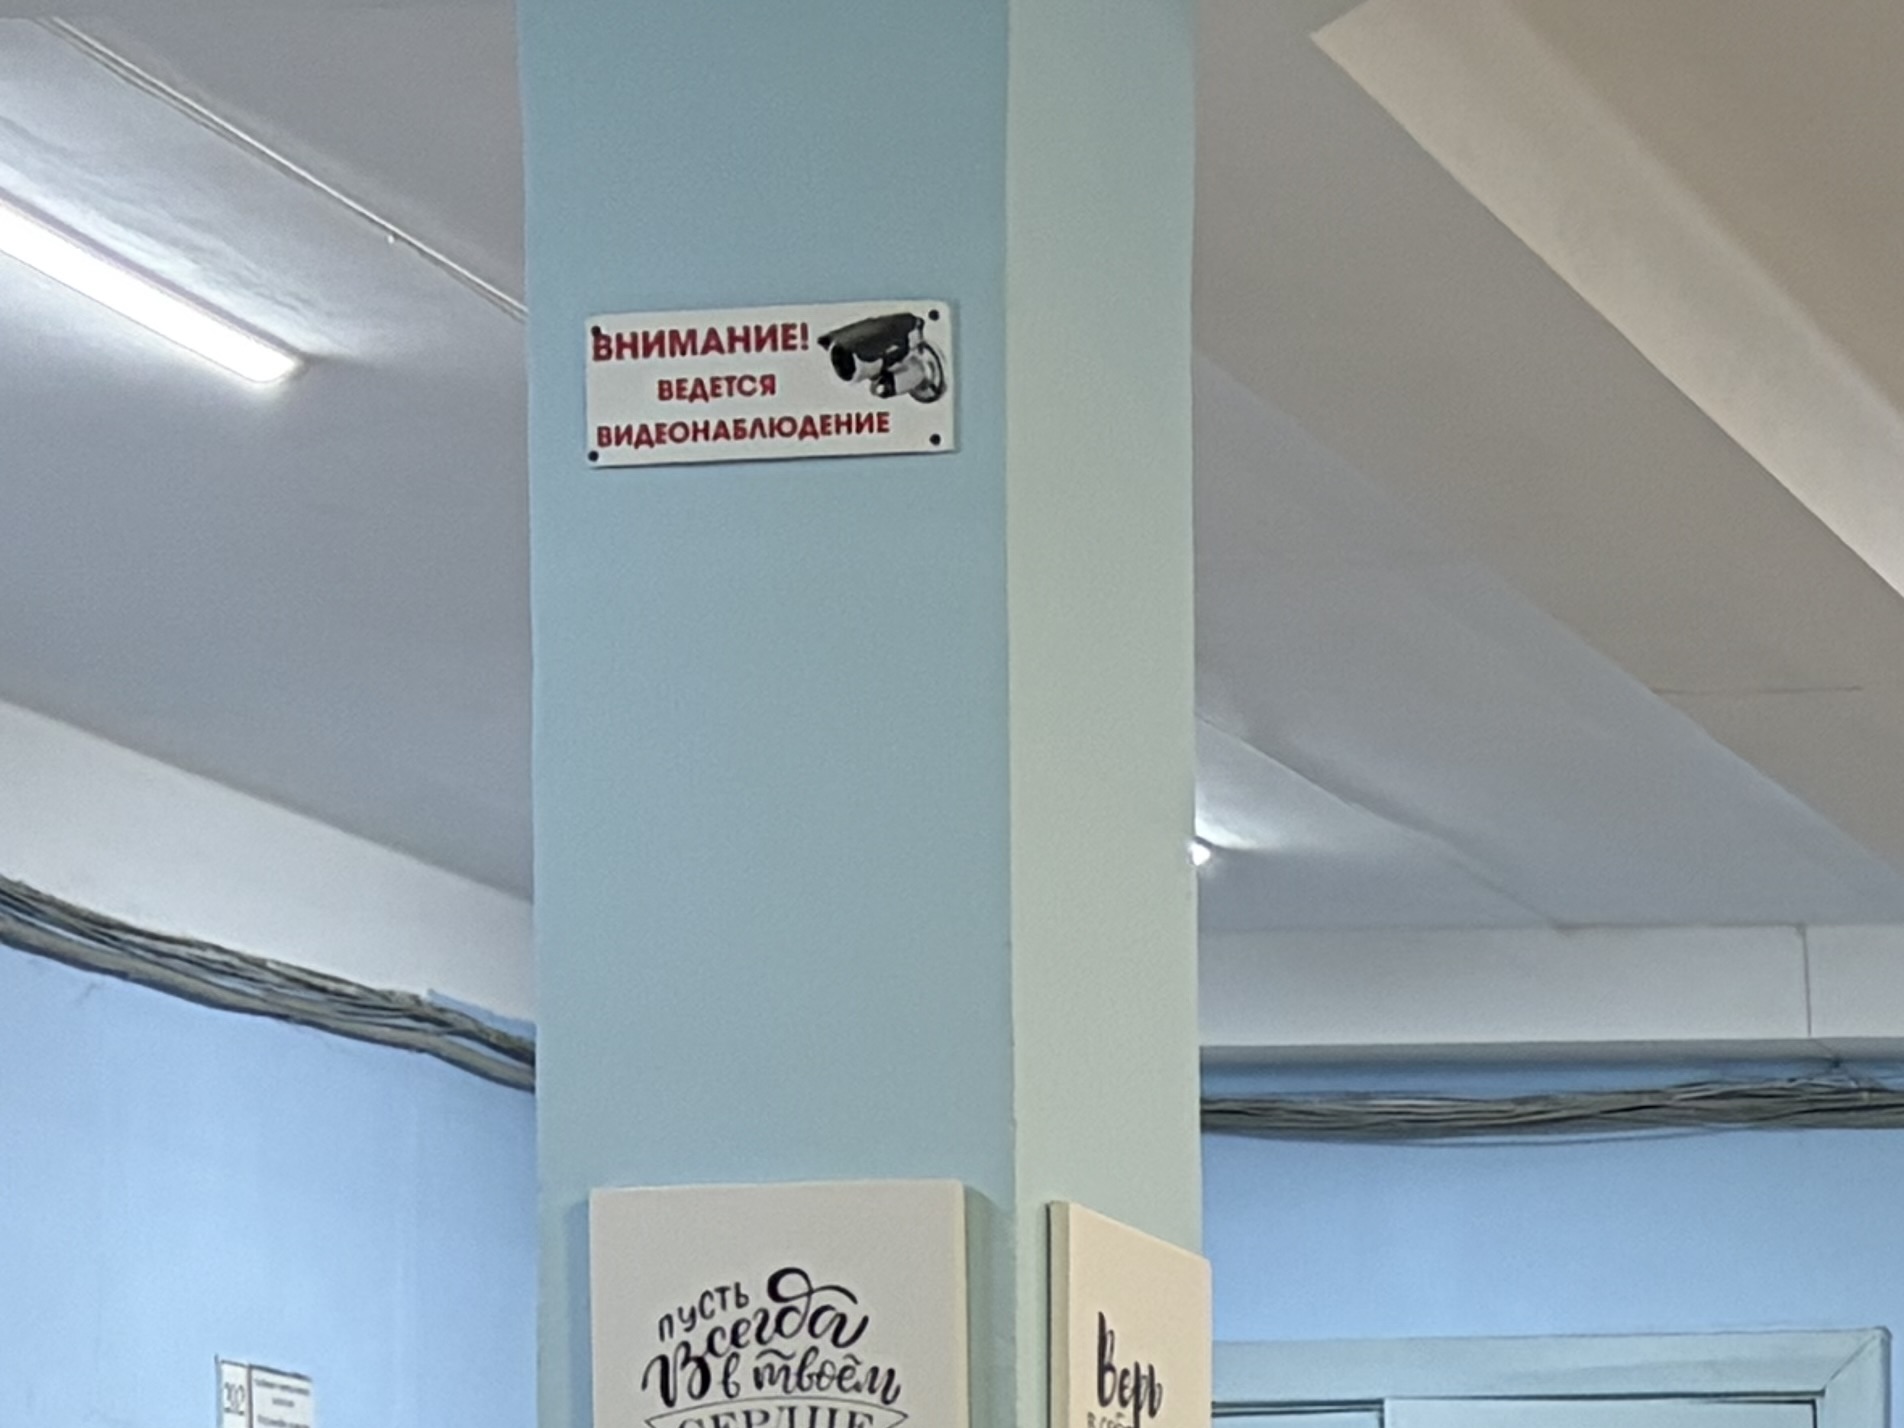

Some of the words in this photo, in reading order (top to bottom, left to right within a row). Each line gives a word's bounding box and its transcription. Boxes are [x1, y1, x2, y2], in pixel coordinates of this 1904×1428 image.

[592, 322, 809, 362] ВНИМАНИЕ!
[657, 374, 777, 403] ВЕДЕТСЯ
[596, 411, 891, 449] ВИДЕОНАБЛЮДЕНИЕ
